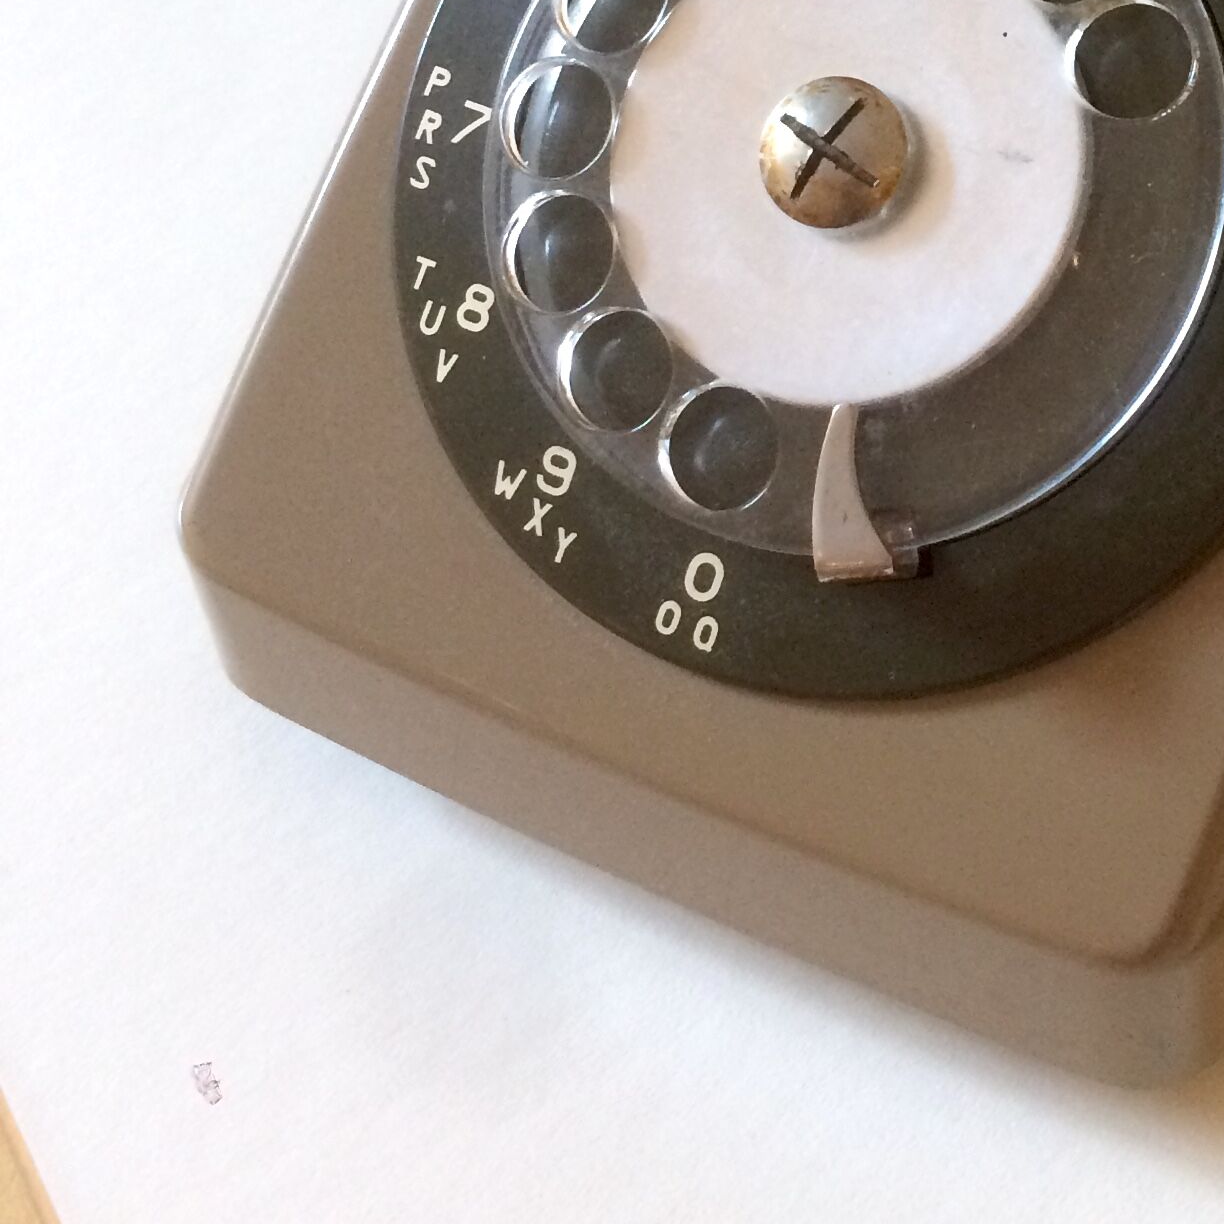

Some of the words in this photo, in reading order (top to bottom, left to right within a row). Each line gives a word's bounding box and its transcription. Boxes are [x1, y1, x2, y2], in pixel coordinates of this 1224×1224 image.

[410, 66, 451, 190] PRS
[450, 99, 493, 144] 7
[413, 256, 458, 383] TUV
[456, 284, 495, 332] 8
[536, 445, 577, 496] 9
[495, 460, 577, 563] WXY
[684, 552, 725, 602] 0
